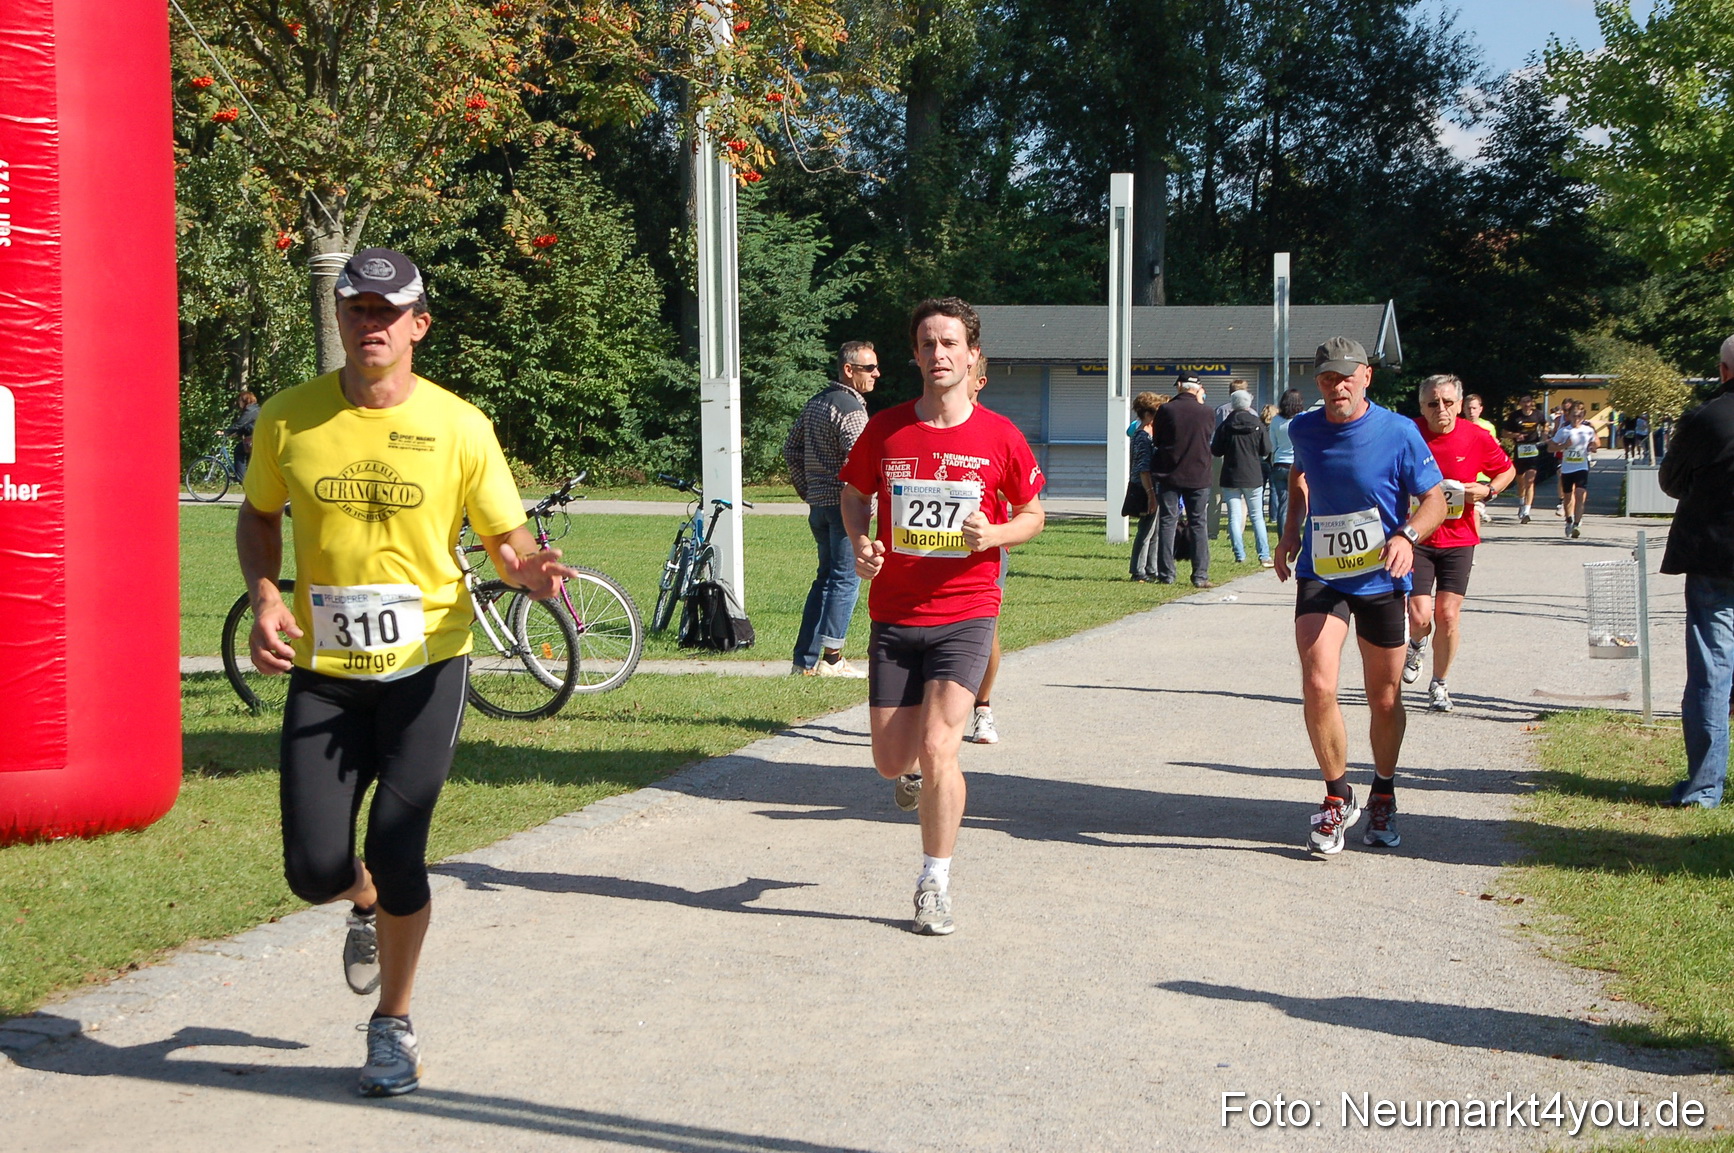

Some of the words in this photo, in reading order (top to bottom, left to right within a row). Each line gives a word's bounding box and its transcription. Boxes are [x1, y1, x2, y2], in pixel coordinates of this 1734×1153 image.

[941, 458, 980, 469] STADTLAUF
[943, 453, 990, 466] NEUMARKTER
[342, 463, 399, 482] PIZZERIA
[0, 474, 42, 501] her
[329, 481, 410, 504] FRANCESCO
[903, 485, 942, 494] PFLEIDERER
[908, 500, 961, 529] 237
[902, 530, 964, 547] Joachim
[1323, 528, 1369, 556] 790
[1336, 555, 1364, 570] Uwe
[333, 609, 400, 648] 310
[343, 651, 396, 673] Jorge
